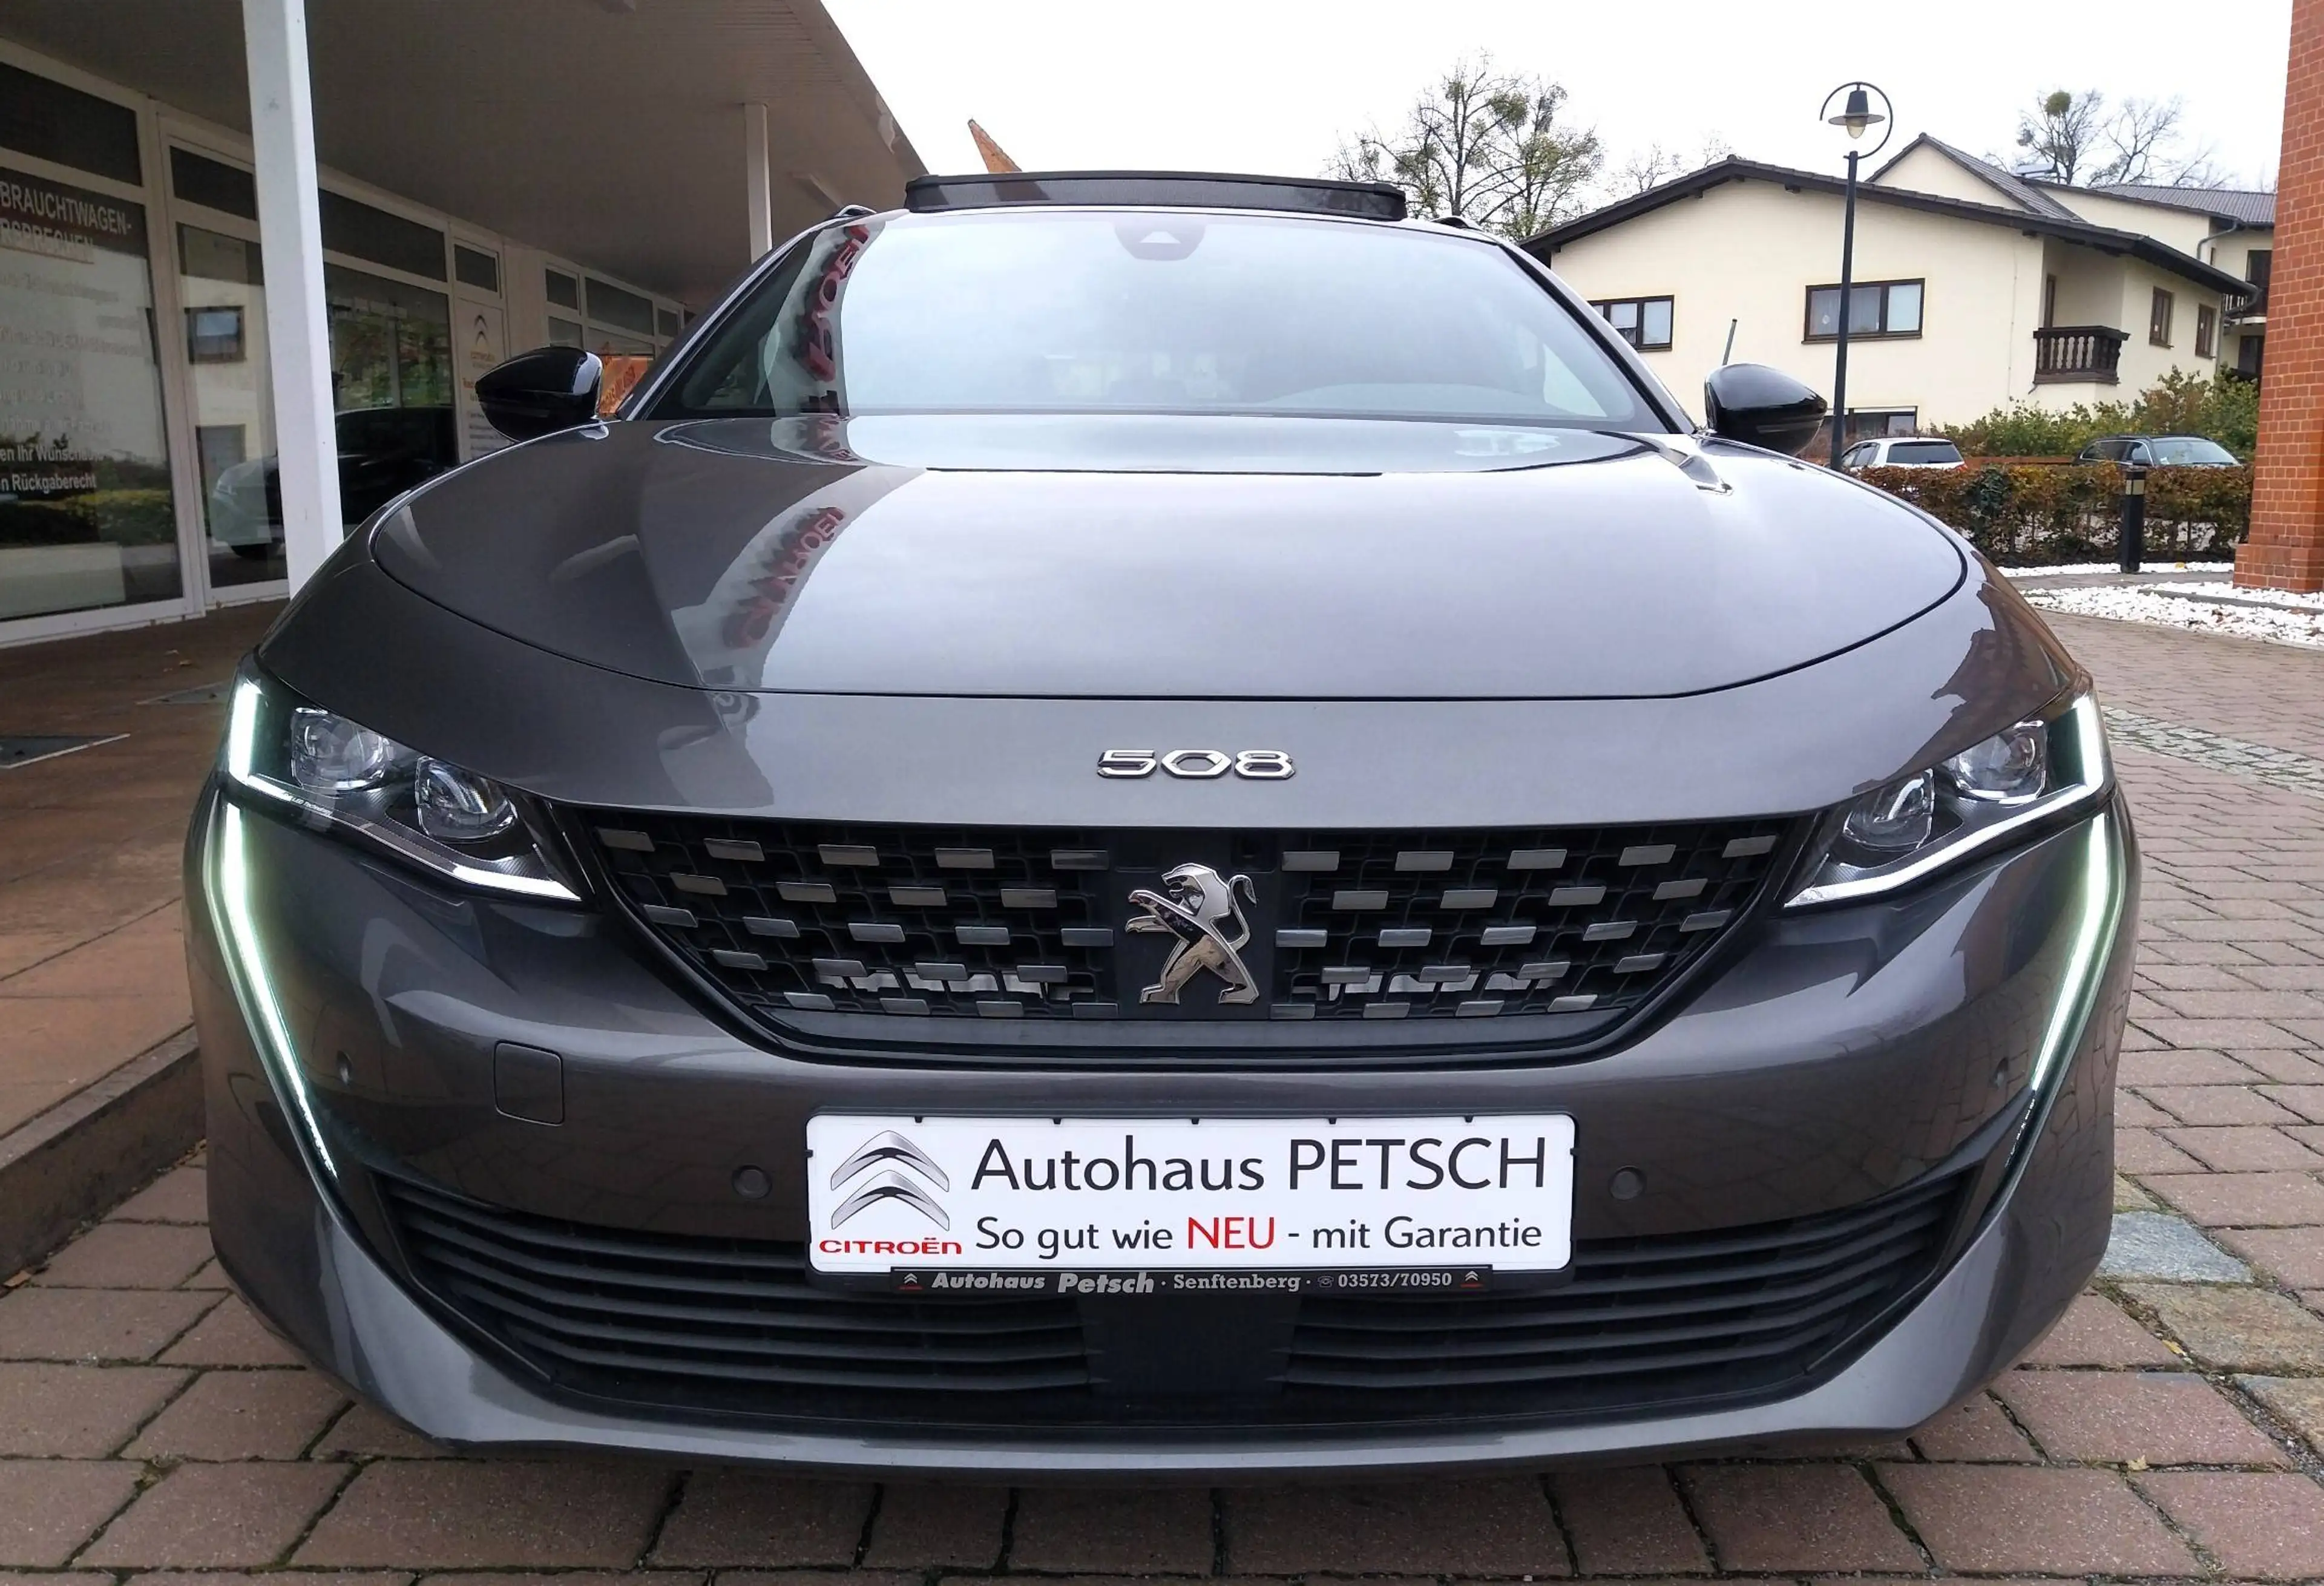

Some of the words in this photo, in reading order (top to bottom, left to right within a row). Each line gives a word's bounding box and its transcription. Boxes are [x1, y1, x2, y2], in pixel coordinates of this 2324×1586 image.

[18, 445, 33, 462] Ihr
[1097, 750, 1296, 780] 508
[971, 1135, 1264, 1191] Autohaus
[1290, 1137, 1545, 1190] PETSCH
[976, 1216, 1024, 1250] So
[1037, 1224, 1100, 1260] gut
[1112, 1219, 1173, 1250] wie
[1188, 1217, 1275, 1250] NEU
[1313, 1219, 1371, 1248] mit
[1384, 1216, 1542, 1248] Garantie
[931, 1273, 1045, 1289] Autohaus
[1057, 1272, 1154, 1293] Petsch
[1173, 1274, 1301, 1292] Senftenberg
[1338, 1273, 1452, 1288] 03573/70950
